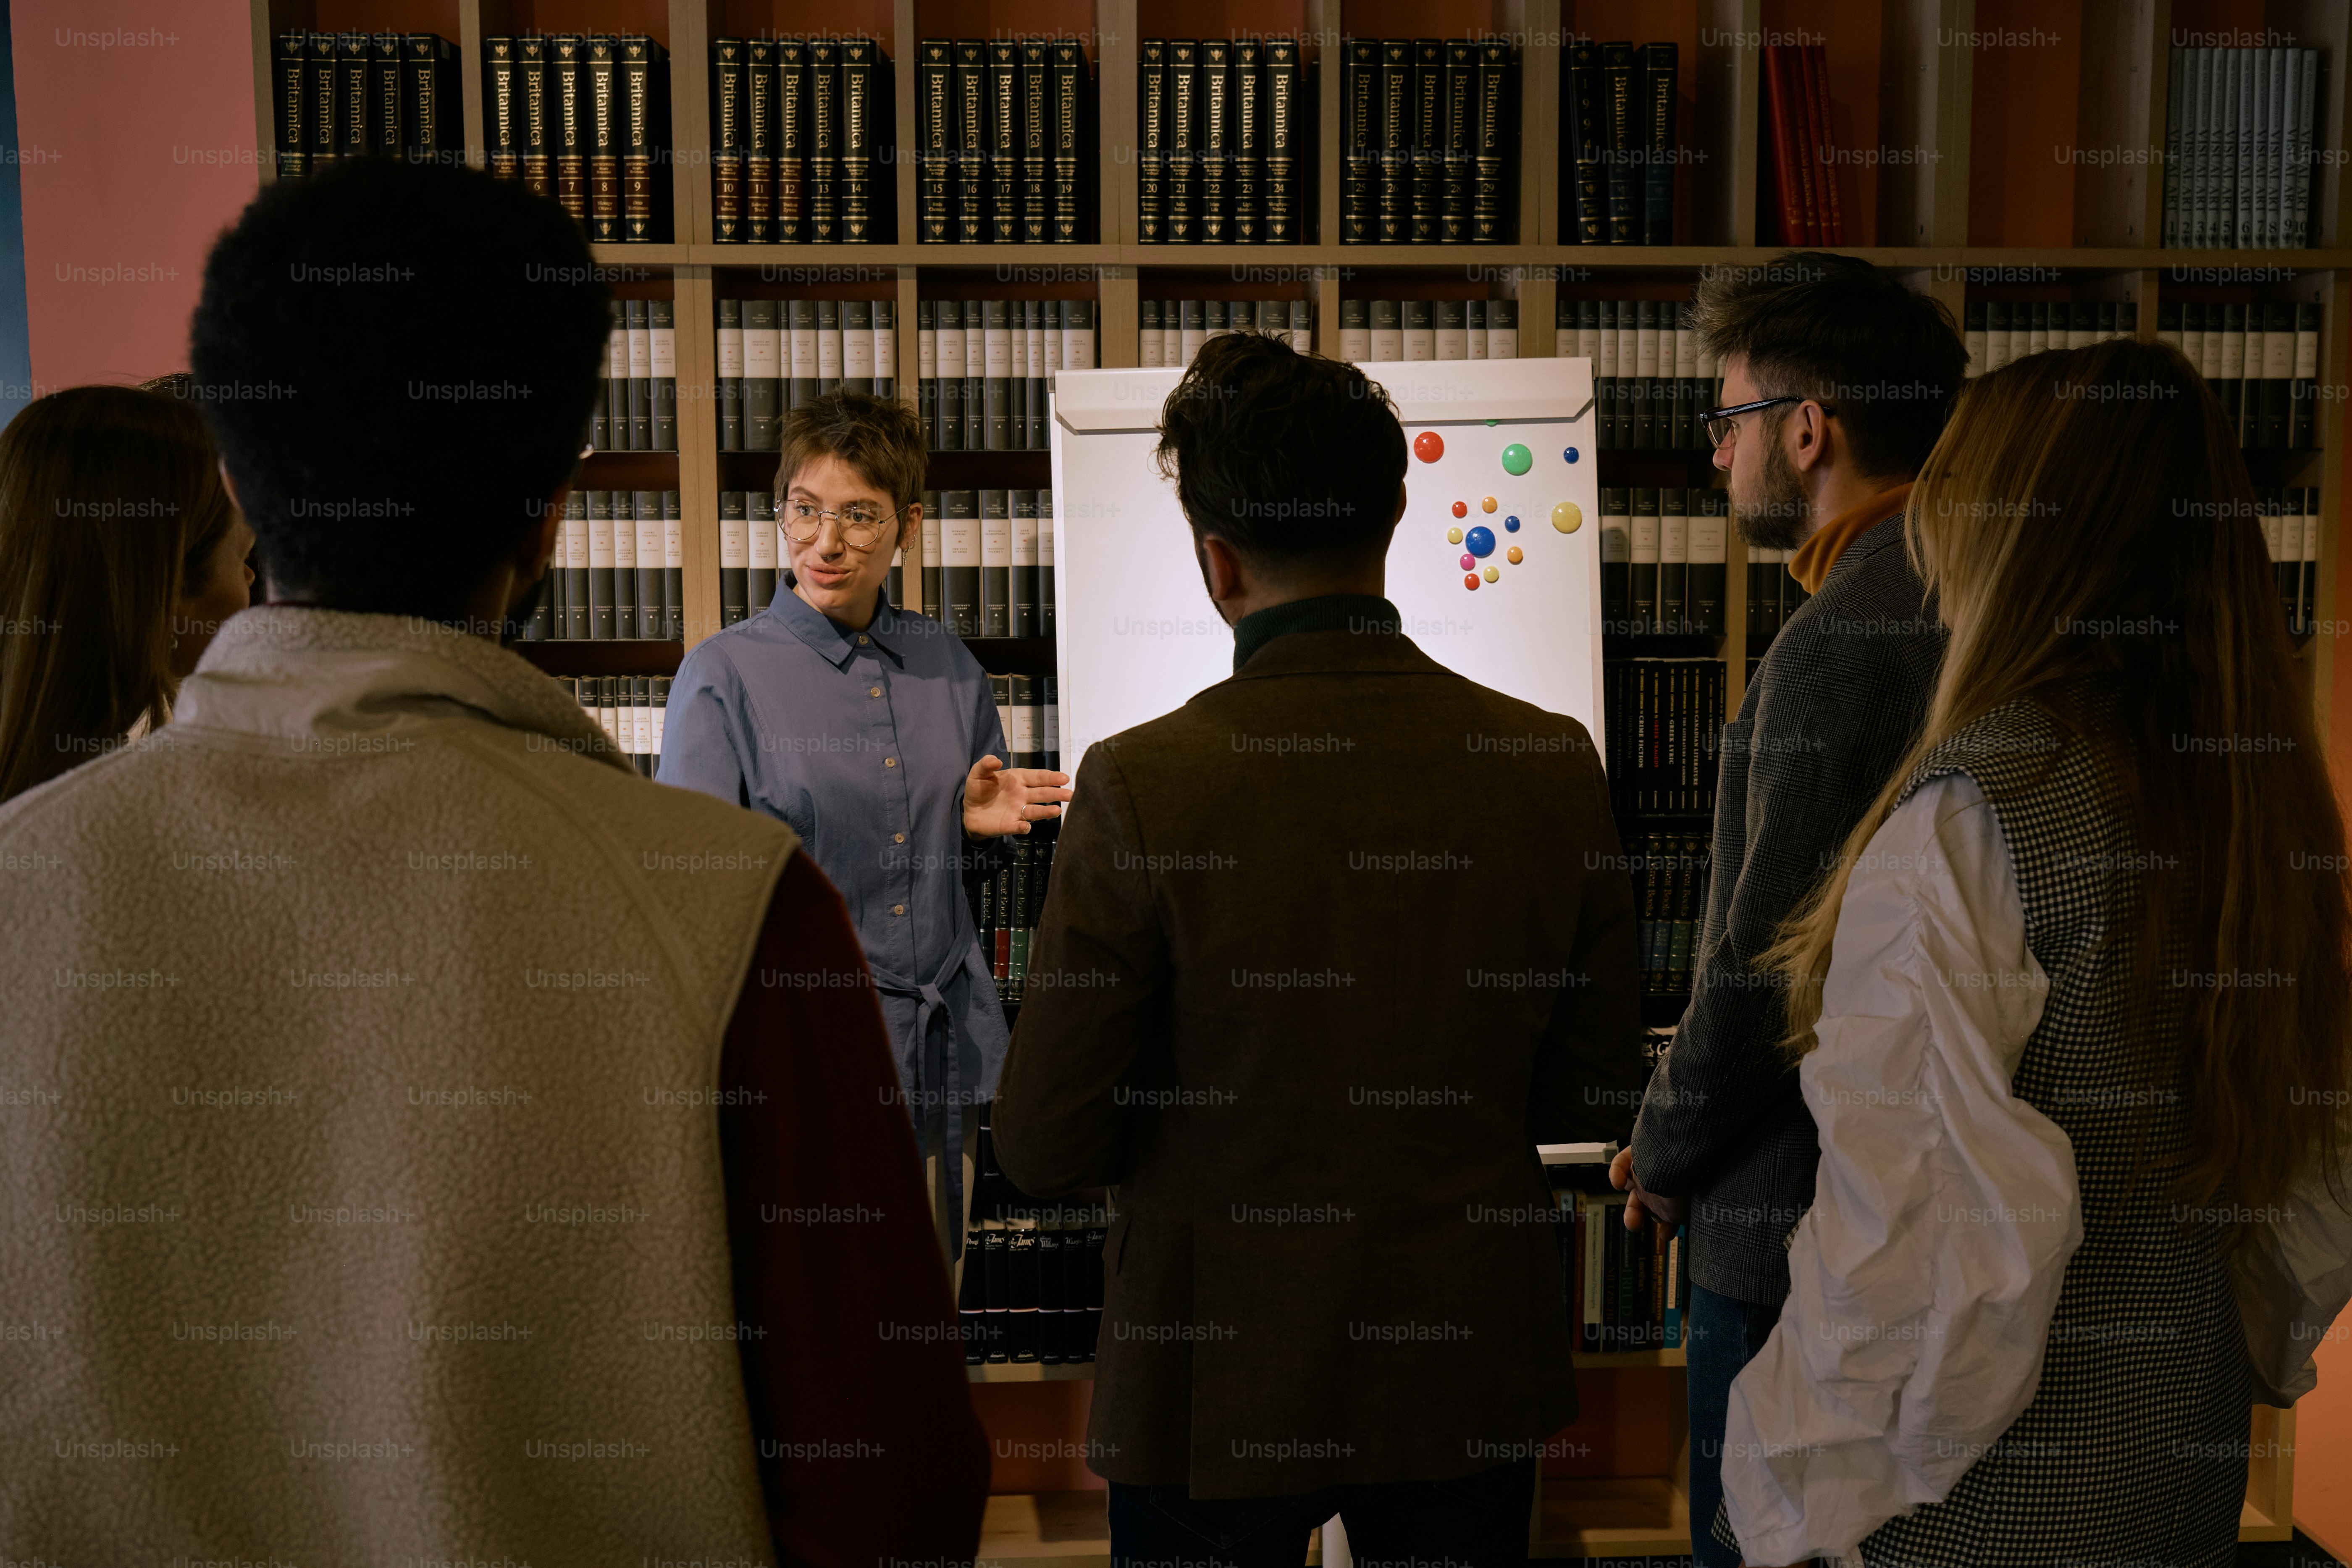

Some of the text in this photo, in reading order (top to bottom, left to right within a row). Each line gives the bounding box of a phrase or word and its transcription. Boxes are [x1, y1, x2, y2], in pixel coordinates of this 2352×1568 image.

[287, 68, 301, 145] Britannica
[318, 69, 332, 145] Britannica
[350, 69, 363, 145] Britannica
[383, 70, 396, 146] Britannica
[418, 69, 432, 146] Britannica
[497, 71, 511, 147] Britannica
[528, 71, 541, 147] Britannica
[562, 71, 576, 147] Britannica
[596, 72, 609, 147] Britannica
[630, 71, 643, 147] Britannica
[724, 73, 737, 148] Britannica
[756, 74, 769, 148] Britannica
[786, 74, 799, 150] Britannica
[818, 74, 830, 149] Britannica
[852, 74, 864, 149] Britannica
[931, 74, 944, 149] Britannica
[966, 74, 979, 150] Britannica
[1000, 74, 1012, 150] Britannica
[1029, 74, 1042, 149] Britannica
[1061, 74, 1074, 150] Britannica
[1147, 73, 1160, 148] Britannica
[1178, 74, 1191, 149] Britannica
[1211, 74, 1224, 150] Britannica
[1243, 74, 1255, 149] Britannica
[1276, 74, 1288, 149] Britannica
[1357, 74, 1370, 148] Britannica
[1390, 74, 1404, 148] Britannica
[1423, 74, 1436, 148] Britannica
[1453, 74, 1467, 148] Britannica
[1486, 74, 1501, 148] Britannica
[1614, 76, 1629, 150] Britannica
[1656, 77, 1670, 150] Britannica
[533, 181, 540, 190] 6
[568, 181, 575, 191] 7
[601, 182, 608, 191] 8
[634, 182, 641, 191] 9
[723, 184, 734, 193] 10
[755, 184, 763, 193] 11
[785, 184, 795, 194] 12
[819, 184, 829, 193] 13
[851, 183, 861, 192] 14
[933, 184, 943, 193] 15
[967, 184, 977, 193] 16
[1001, 184, 1010, 193] 17
[1030, 183, 1040, 192] 18
[1062, 183, 1071, 192] 19
[1146, 183, 1157, 193] 20
[1176, 183, 1186, 192] 21
[1210, 183, 1220, 193] 22
[1242, 183, 1253, 193] 23
[1274, 183, 1284, 192] 24
[1356, 183, 1366, 192] 25
[1387, 183, 1398, 192] 26
[1421, 183, 1431, 192] 27
[1451, 183, 1461, 192] 28
[1483, 183, 1495, 192] 29
[2167, 185, 2178, 212] ART
[2284, 184, 2294, 211] ART
[2182, 187, 2192, 213] ART
[2196, 187, 2206, 213] ART
[2209, 186, 2219, 213] ART
[2222, 186, 2233, 213] ART
[2241, 186, 2251, 214] ART
[2256, 186, 2265, 213] ART
[2268, 187, 2278, 214] ART
[2296, 186, 2306, 213] ART
[2170, 222, 2174, 232] 1
[2182, 222, 2190, 234] 2
[2197, 221, 2205, 233] 3
[2210, 222, 2217, 233] 4
[2223, 221, 2231, 233] 5
[2242, 221, 2250, 234] 6
[2258, 221, 2265, 232] 7
[2269, 222, 2276, 234] 8
[2284, 220, 2292, 231] 9
[2295, 221, 2307, 233] 10
[1037, 869, 1045, 893] Great
[1000, 869, 1009, 925] Great Books
[1016, 869, 1027, 925] Great Books
[1646, 889, 1656, 917] Books
[1681, 889, 1691, 917] Books
[1606, 1266, 1615, 1321] NIETZSCHE
[1621, 1268, 1633, 1316] FREUD
